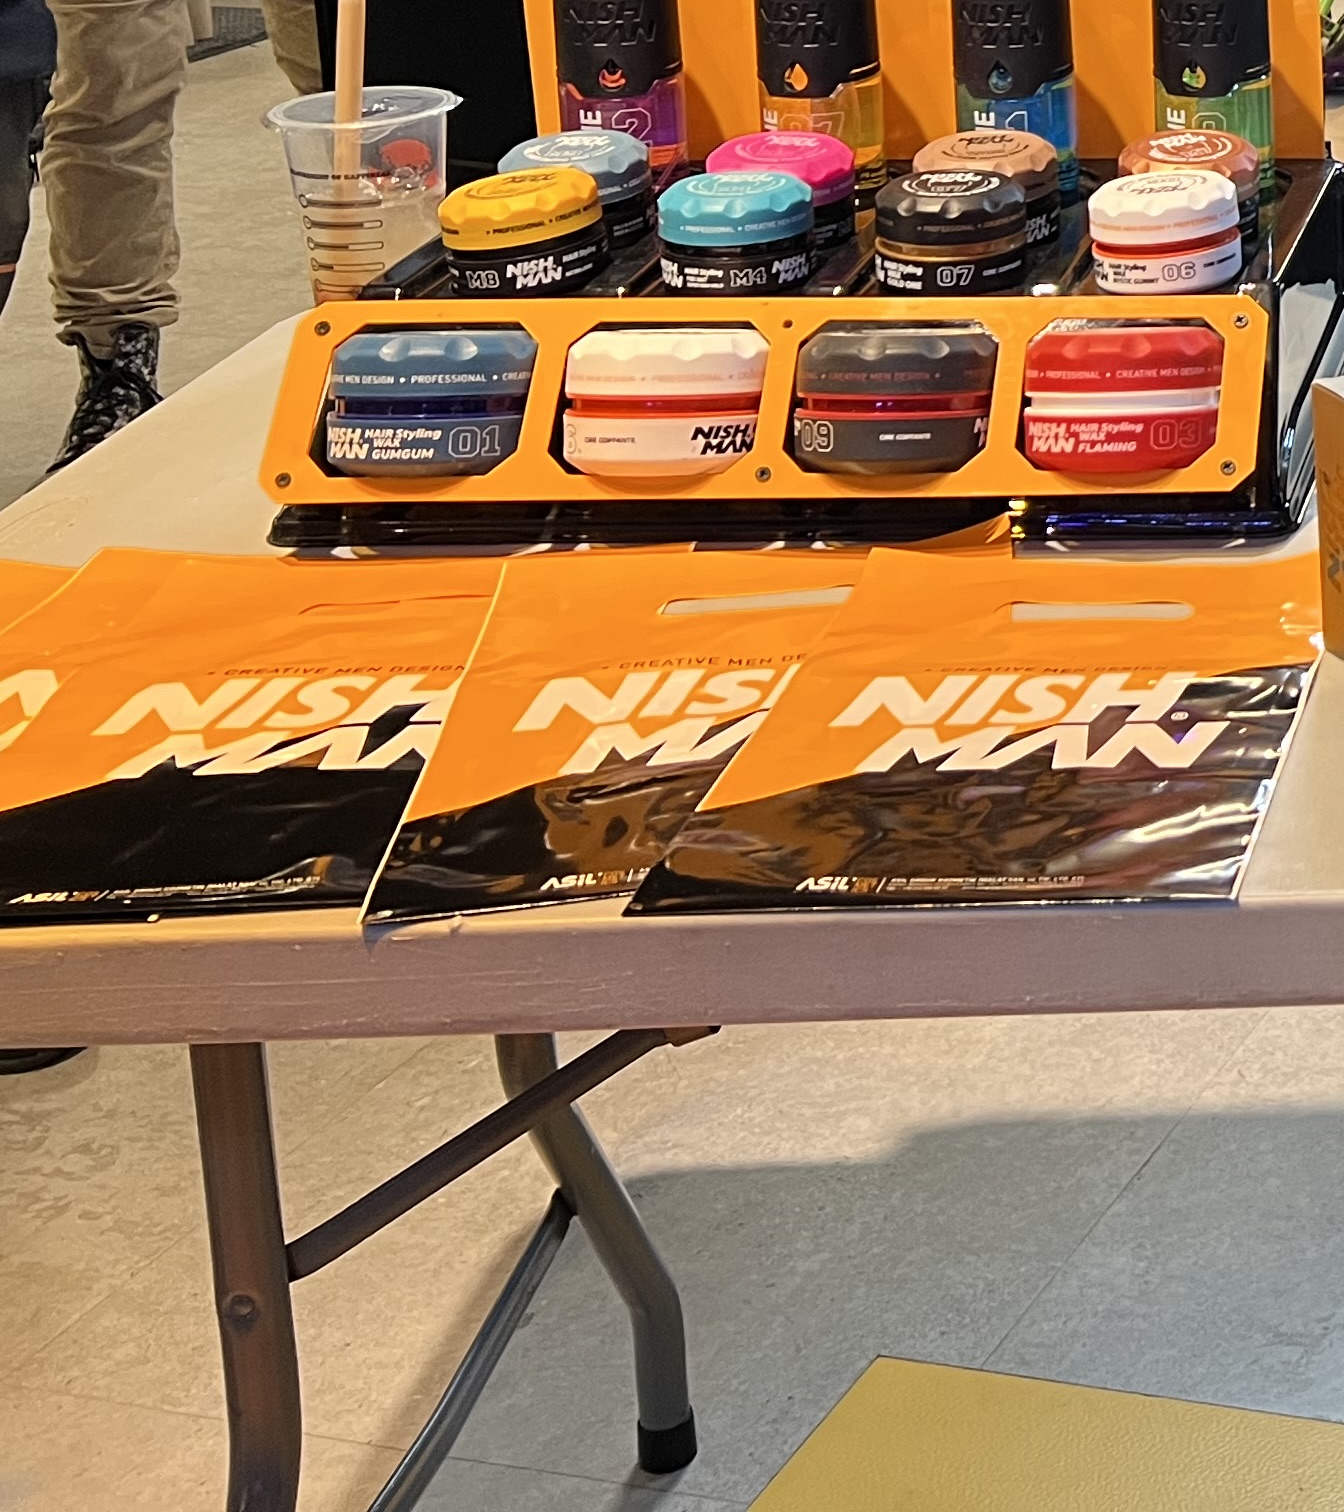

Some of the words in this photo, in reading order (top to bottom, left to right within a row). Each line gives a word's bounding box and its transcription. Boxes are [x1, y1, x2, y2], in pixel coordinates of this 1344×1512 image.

[505, 255, 557, 278] NISH
[771, 252, 807, 274] NISH
[1161, 261, 1197, 282] 06
[516, 266, 563, 290] MAN
[729, 266, 768, 288] M4
[936, 264, 976, 287] 07
[362, 375, 395, 385] DESIGN
[410, 373, 487, 384] PROFESSIONAL
[1116, 368, 1157, 379] CREATIVE
[1159, 367, 1179, 377] MEN
[364, 428, 394, 439] HAIR
[395, 428, 442, 441] Styling
[690, 423, 751, 441] NISH
[800, 419, 834, 453] 09
[1028, 420, 1067, 439] NISH
[1070, 423, 1099, 434] HAIR
[1100, 420, 1144, 435] Styling
[1078, 431, 1106, 442] WAX
[372, 438, 401, 448] WAX
[448, 424, 501, 458] 01
[1031, 436, 1076, 454] MAN
[1076, 441, 1137, 455] FLAMING
[371, 448, 435, 460] GUMGUM
[224, 664, 328, 677] CREATIVE
[335, 664, 383, 675] MEN
[388, 662, 467, 674] DESIGN
[619, 656, 720, 670] CREATIVE
[727, 655, 772, 667] MEN
[90, 673, 462, 737] NISH
[828, 670, 1201, 727] NISH
[851, 721, 1232, 773] MAN
